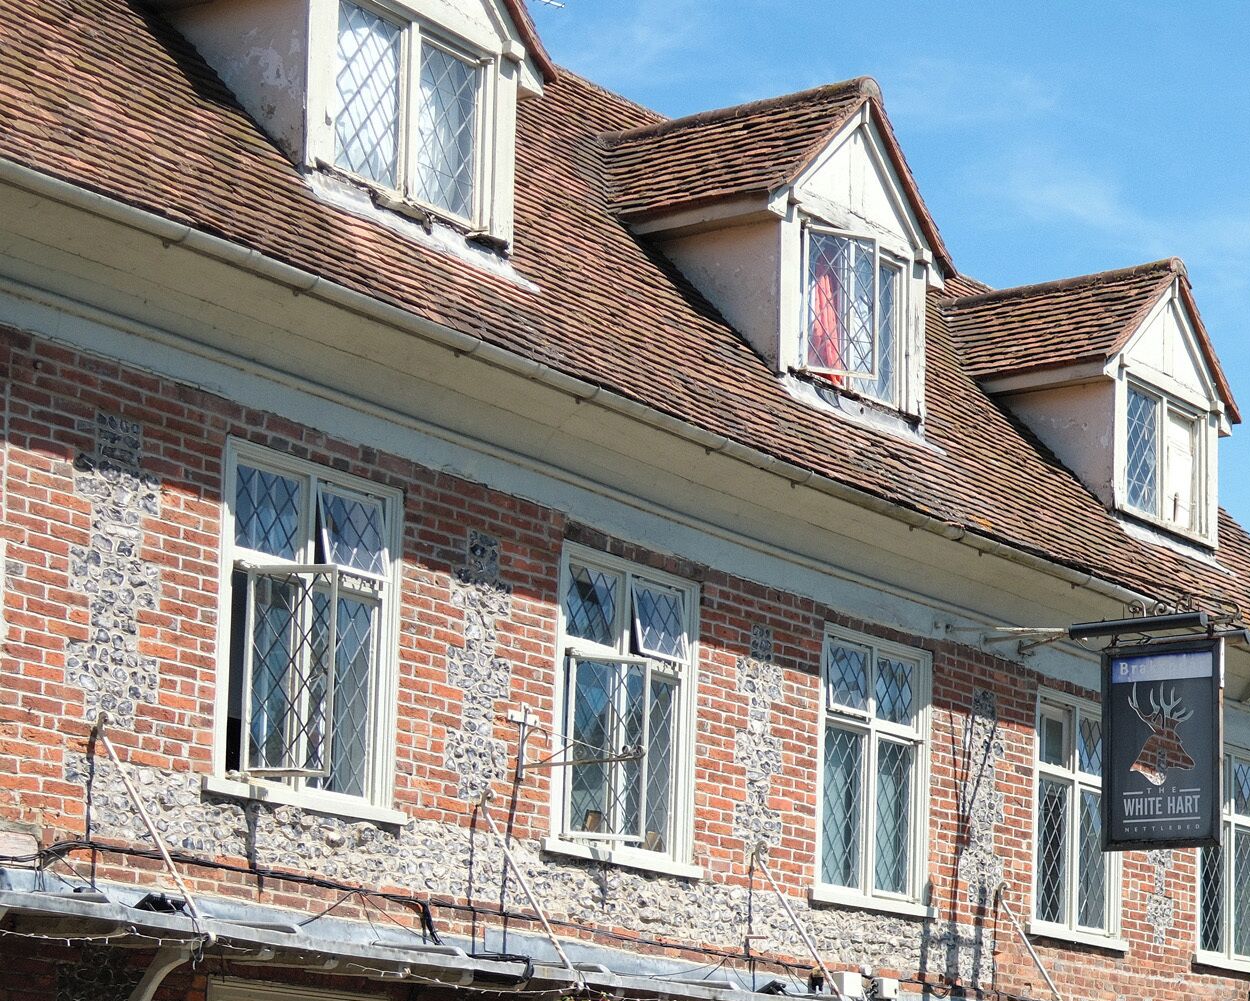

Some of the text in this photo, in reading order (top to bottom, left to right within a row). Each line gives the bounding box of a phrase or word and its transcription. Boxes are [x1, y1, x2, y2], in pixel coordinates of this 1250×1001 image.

[1147, 786, 1177, 794] THE
[1123, 794, 1200, 817] WHITE HART
[1124, 823, 1200, 833] NETTLEBED
